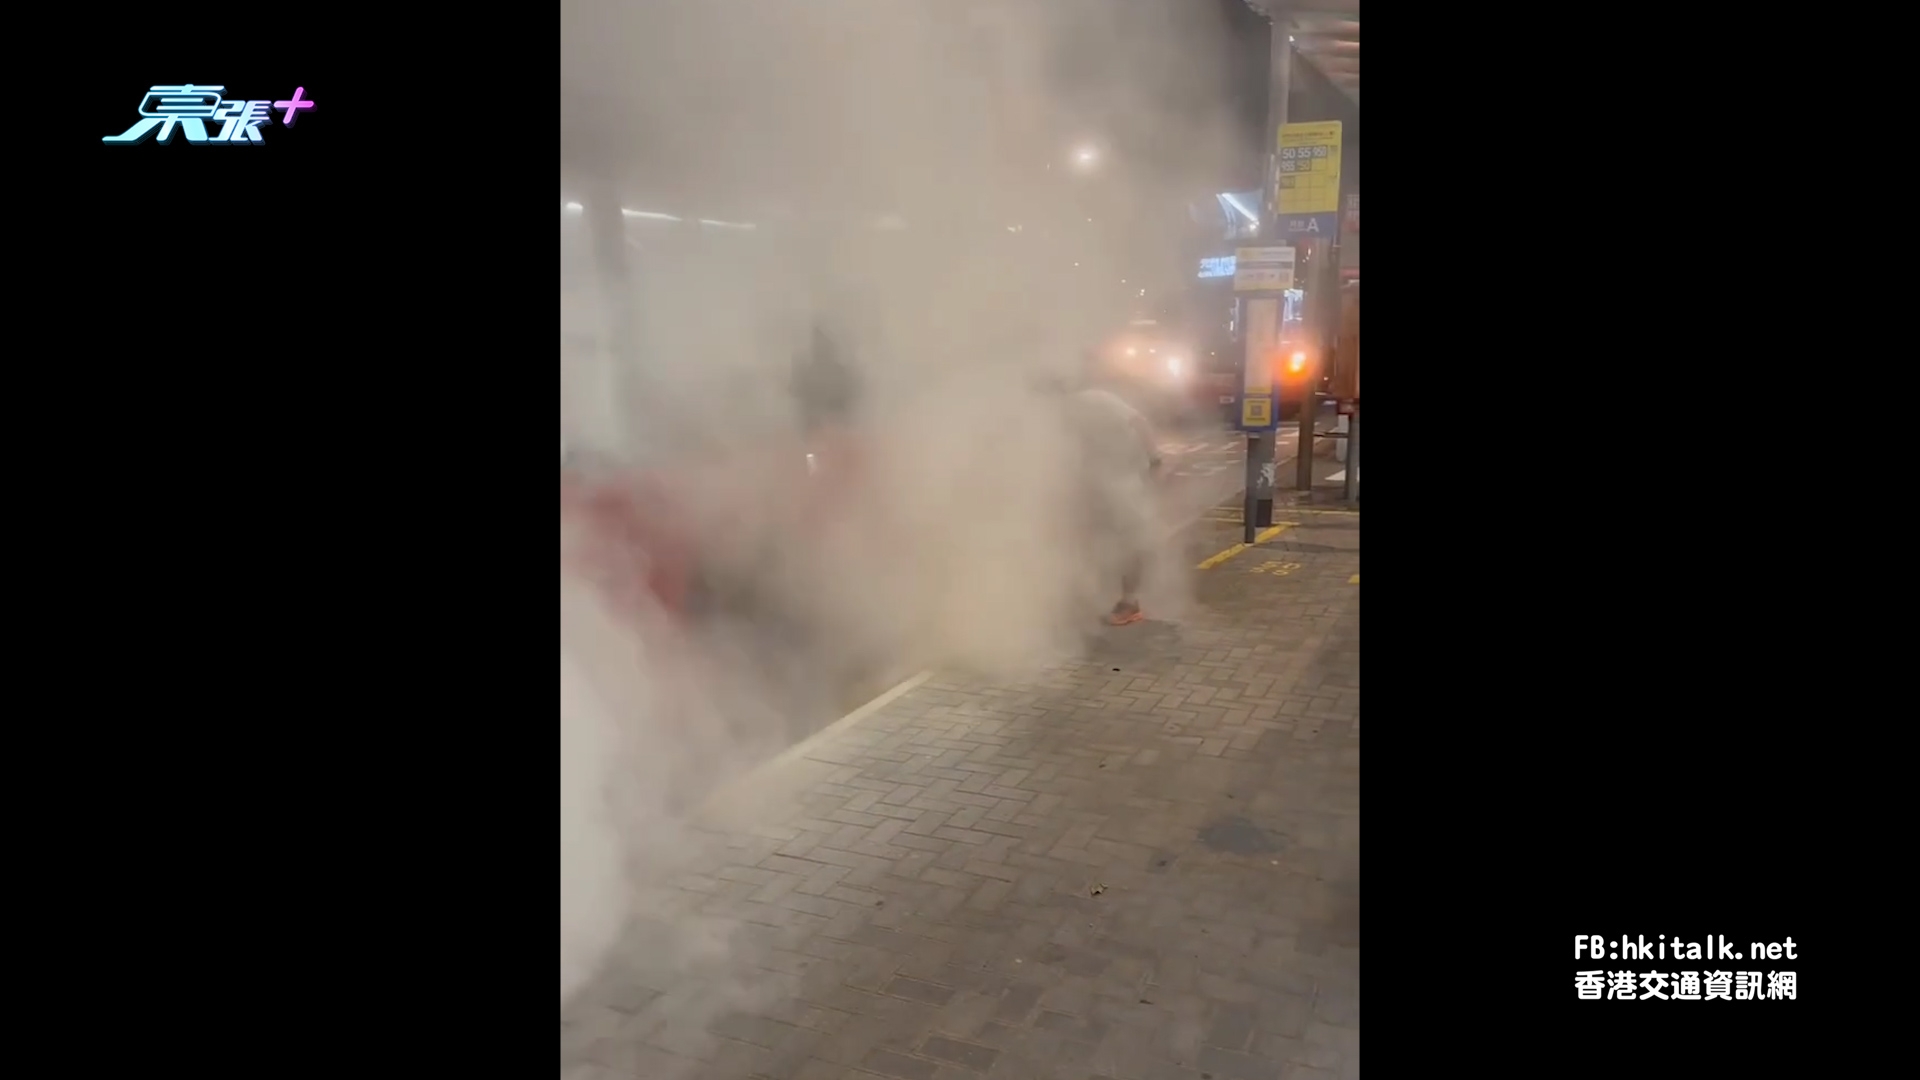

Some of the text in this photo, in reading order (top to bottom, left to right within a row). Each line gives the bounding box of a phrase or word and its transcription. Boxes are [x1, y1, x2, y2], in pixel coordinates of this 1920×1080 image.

[1282, 148, 1296, 159] 50
[1297, 147, 1311, 158] 55
[1306, 217, 1320, 232] A
